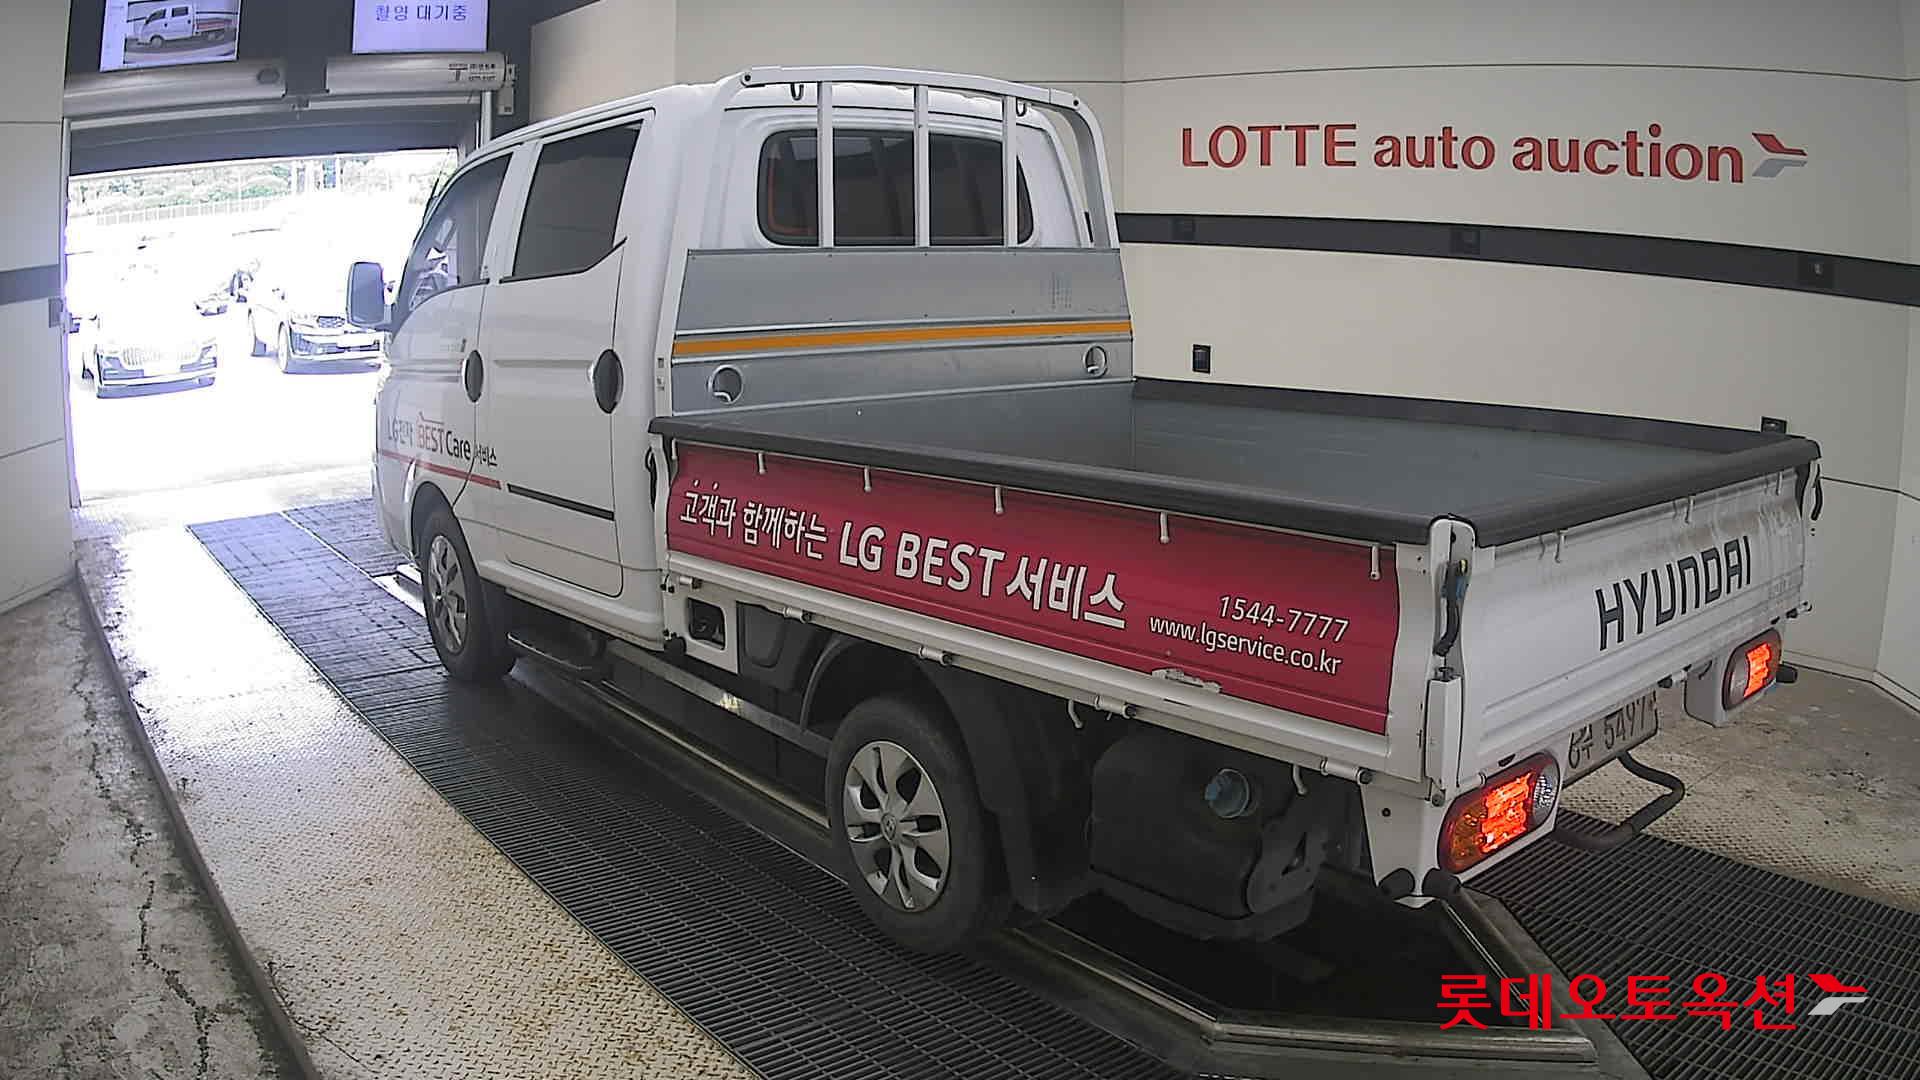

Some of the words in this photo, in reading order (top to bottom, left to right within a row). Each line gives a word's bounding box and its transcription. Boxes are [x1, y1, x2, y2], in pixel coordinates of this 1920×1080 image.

[417, 5, 466, 21] 대기중
[1181, 123, 1357, 168] LOTTE
[1373, 126, 1496, 171] auto
[1511, 123, 1745, 184] auction
[416, 424, 445, 454] BEST
[446, 430, 471, 460] Care
[680, 480, 736, 537] 고객과
[743, 501, 828, 560] 함께하는
[839, 521, 886, 572] LG
[895, 532, 1006, 598] BEST
[1006, 556, 1126, 630] 서비스
[1219, 595, 1349, 643] 1544-7777
[1595, 535, 1751, 651] HYUNDAI
[1150, 616, 1342, 675] www.lgservice.co.kr
